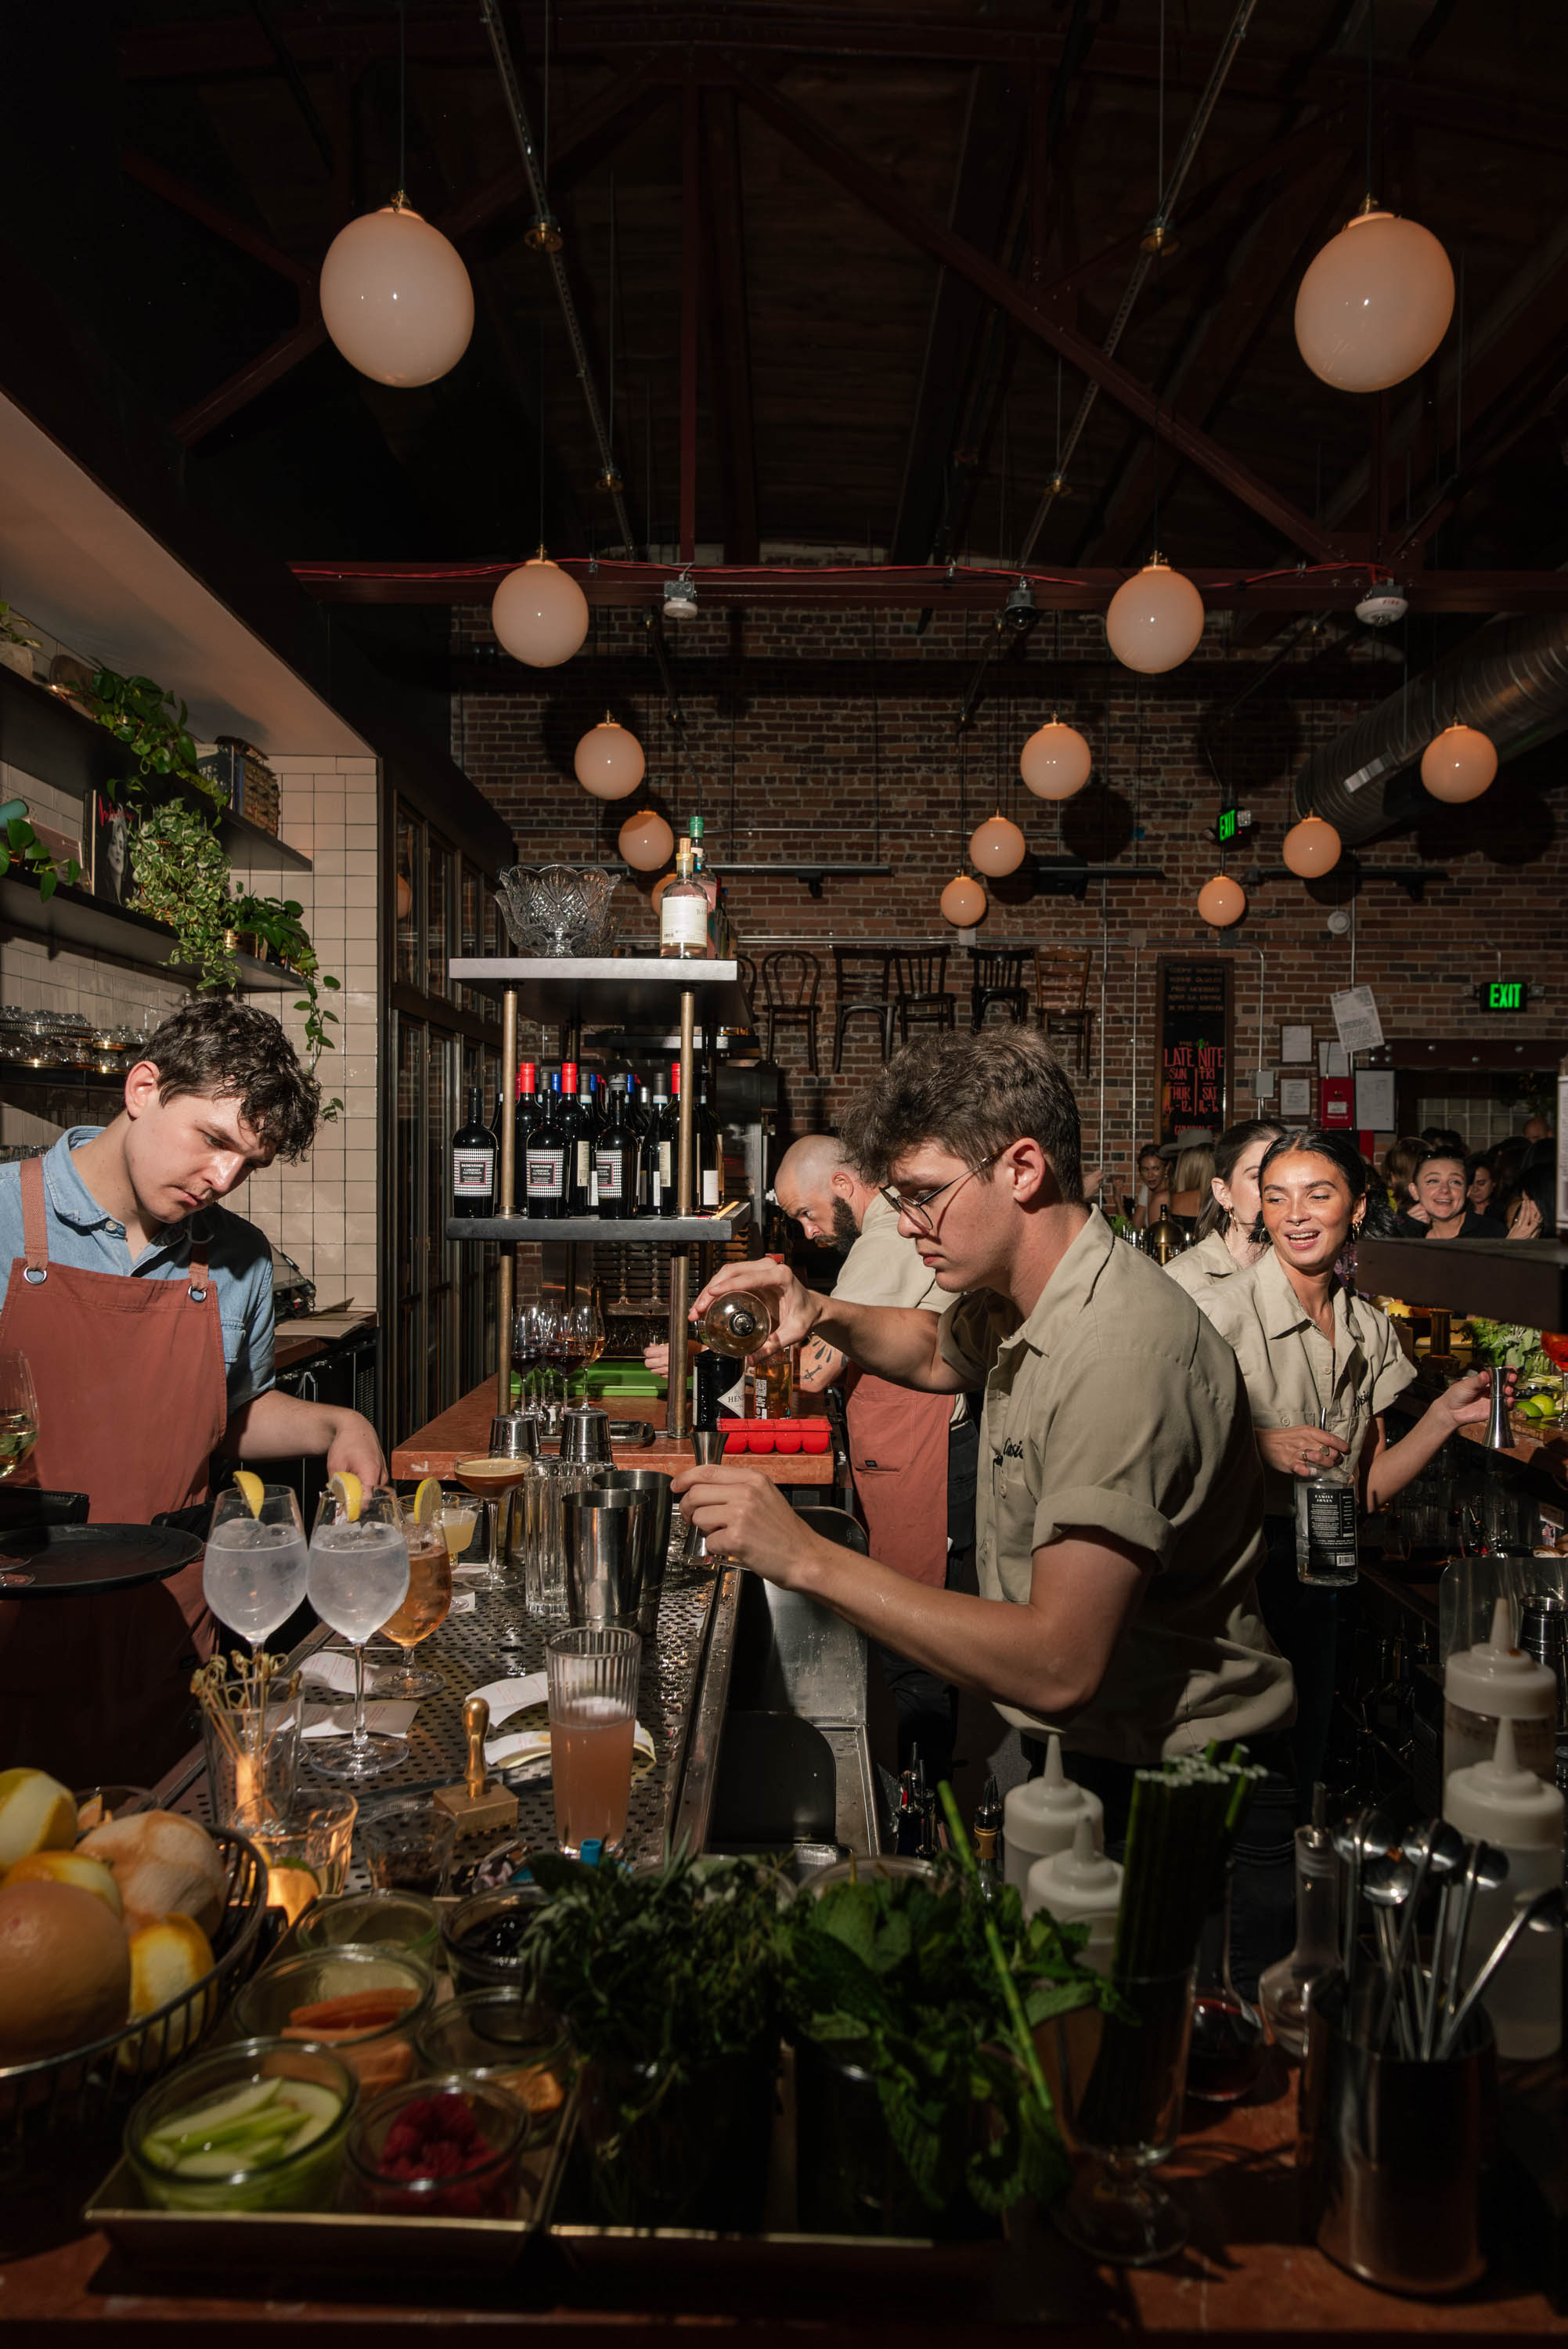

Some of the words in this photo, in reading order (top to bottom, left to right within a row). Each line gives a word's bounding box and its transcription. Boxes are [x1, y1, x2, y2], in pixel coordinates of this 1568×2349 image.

[1220, 809, 1235, 841] EXIT
[1490, 983, 1522, 1009] EXIT
[1164, 1047, 1195, 1067] LATE
[1197, 1046, 1225, 1067] NITE
[1169, 1067, 1188, 1080] SUN
[1200, 1067, 1216, 1080] FRI
[1202, 1086, 1218, 1100] SAT
